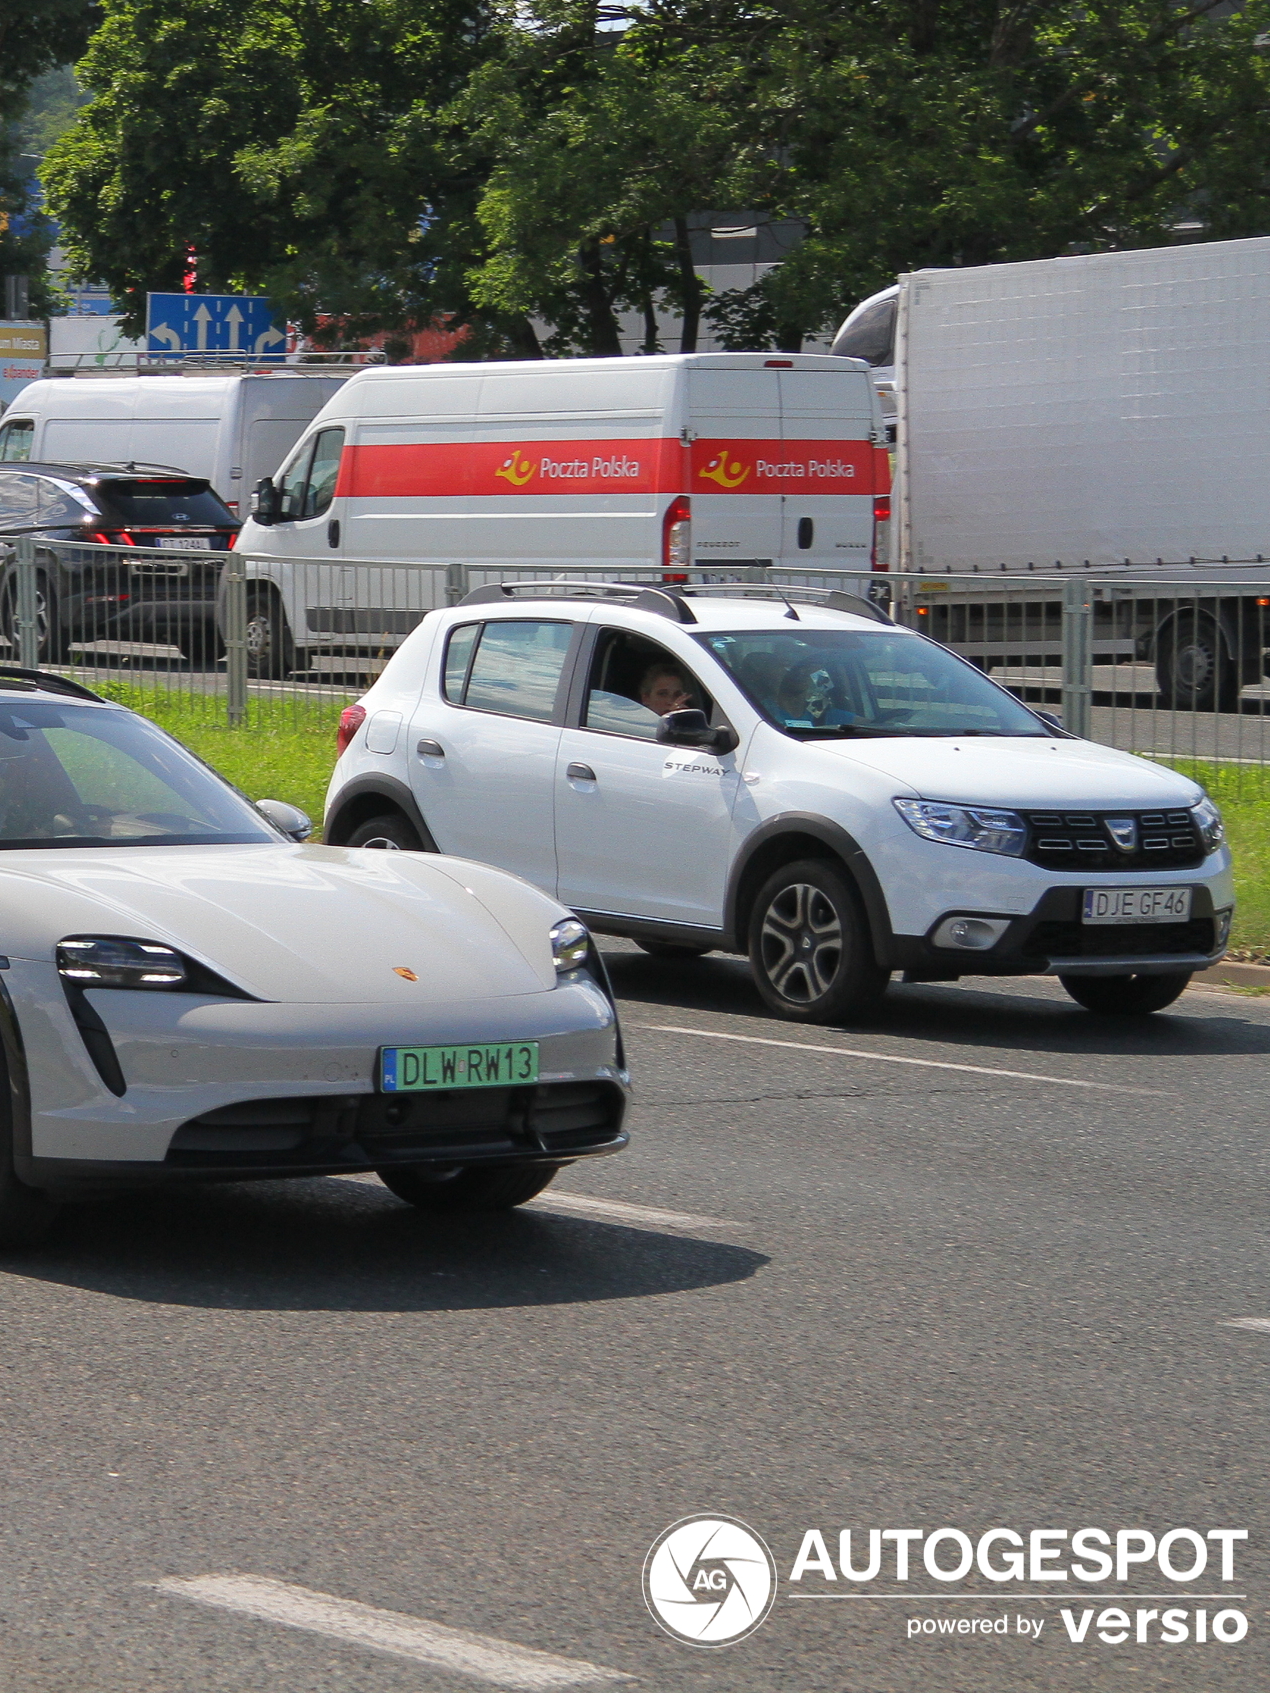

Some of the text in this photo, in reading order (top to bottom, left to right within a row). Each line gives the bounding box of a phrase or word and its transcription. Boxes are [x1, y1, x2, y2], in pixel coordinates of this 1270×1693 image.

[539, 455, 640, 479] Poczta Polska
[756, 459, 855, 478] Poczta Polska
[663, 761, 731, 777] STEPWAY
[1096, 891, 1185, 917] DJE GF46
[384, 1046, 532, 1086] PL DLW RW13
